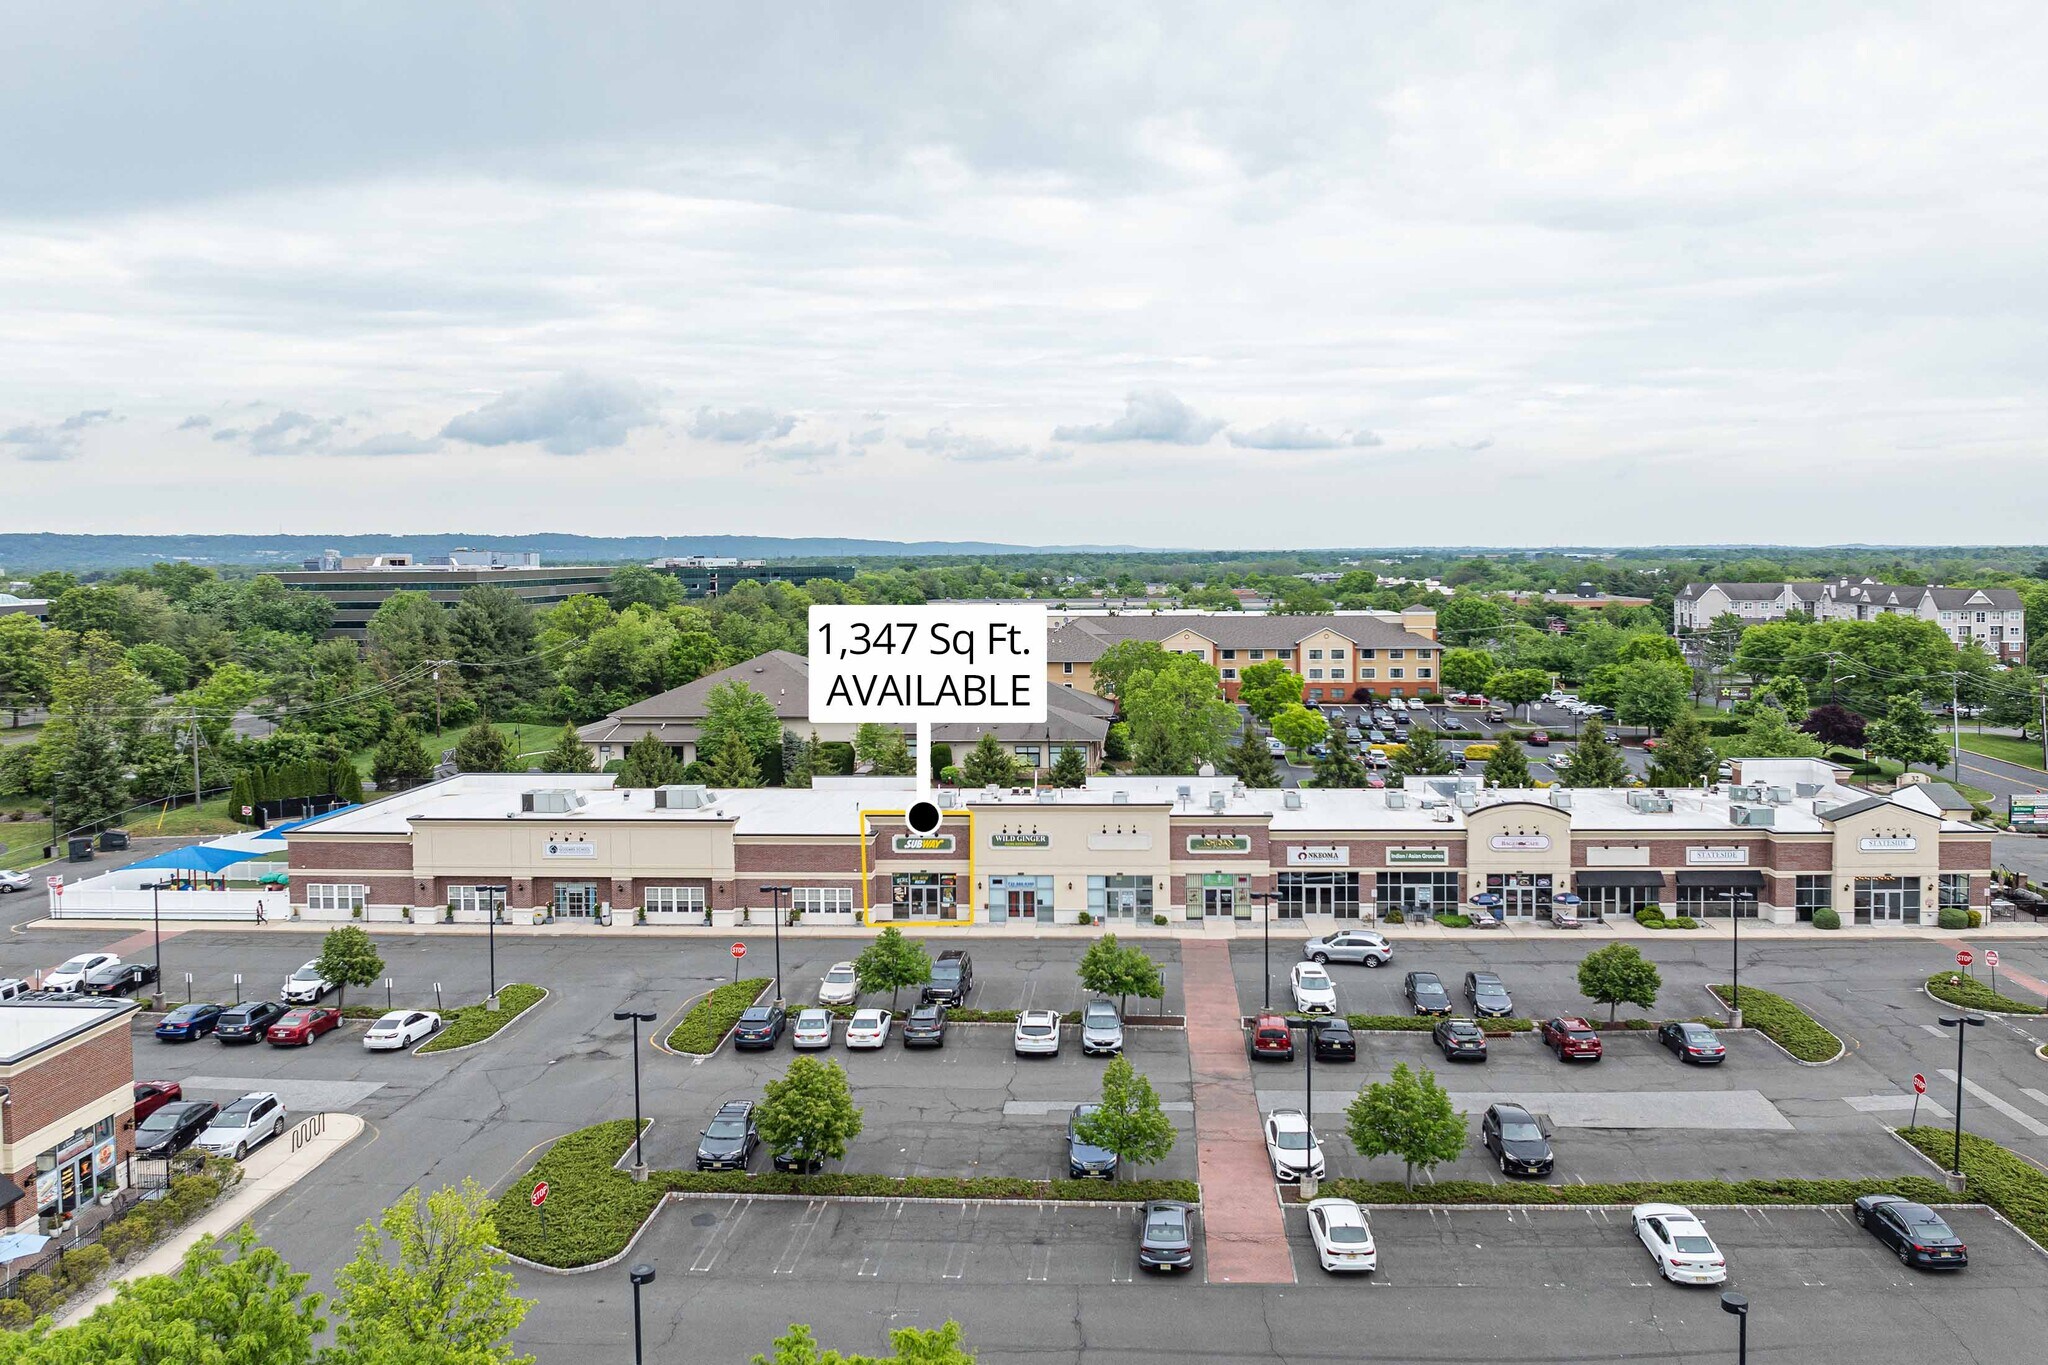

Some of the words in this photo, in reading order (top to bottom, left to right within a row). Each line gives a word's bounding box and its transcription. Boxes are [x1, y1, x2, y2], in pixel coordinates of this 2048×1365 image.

[904, 839, 945, 849] SUBWAY
[1913, 1077, 1926, 1090] STOP
[533, 1185, 548, 1202] STOP
